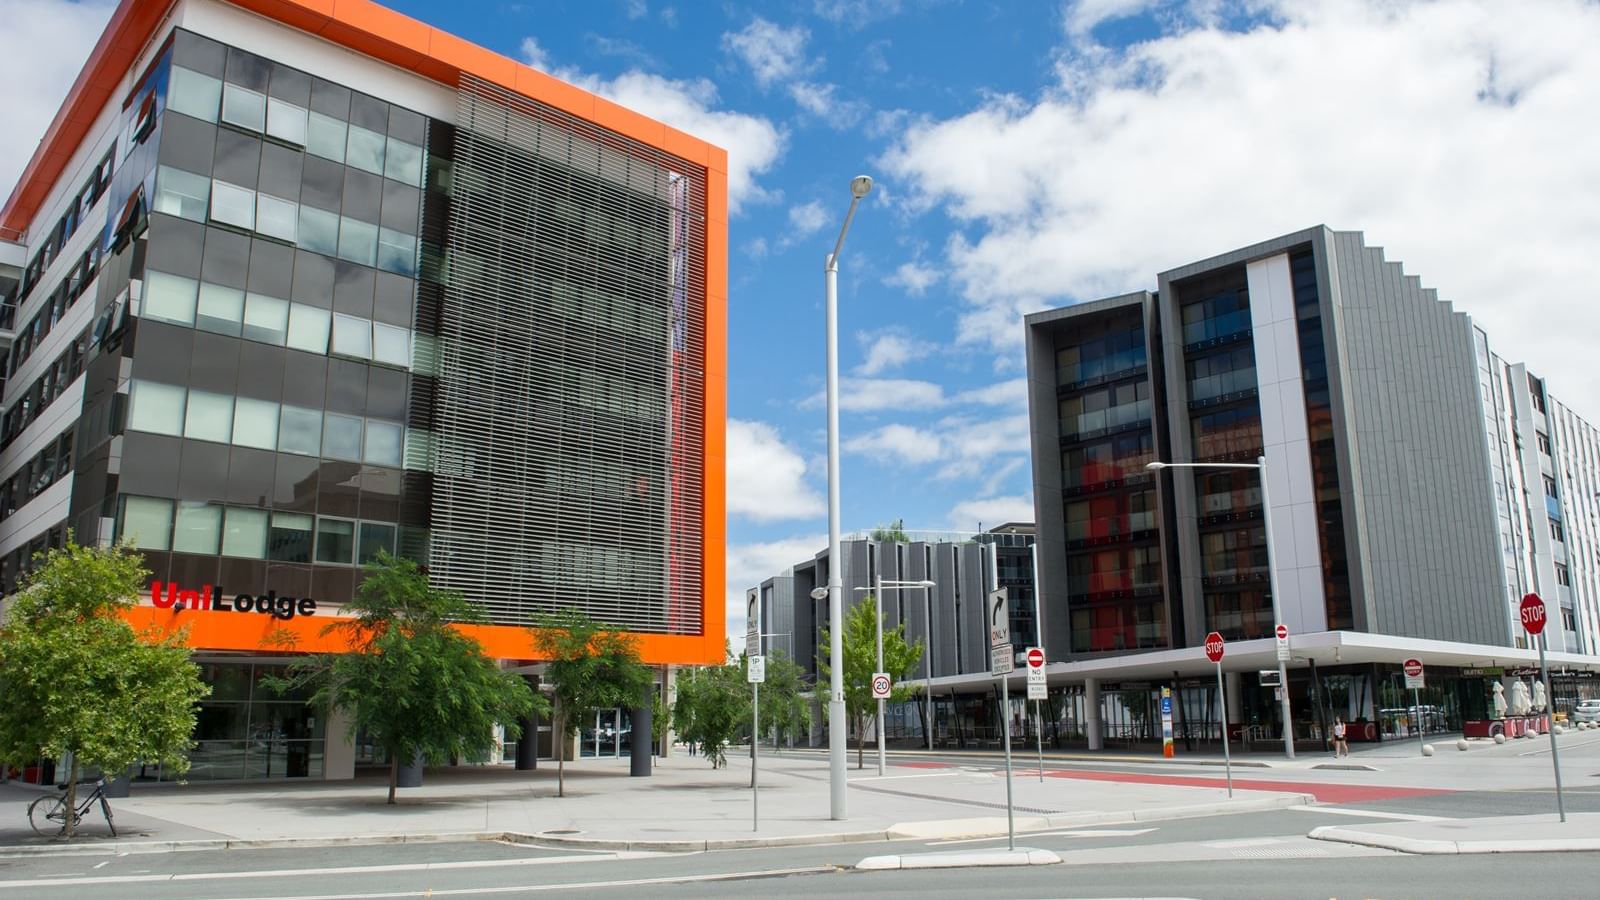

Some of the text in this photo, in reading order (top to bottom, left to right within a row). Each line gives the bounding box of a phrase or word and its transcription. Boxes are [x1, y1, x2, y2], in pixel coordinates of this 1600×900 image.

[151, 580, 317, 620] UniLodge
[1522, 605, 1544, 623] STOP
[992, 629, 1007, 640] ONLY
[1207, 642, 1223, 654] STOP
[876, 681, 888, 690] 20
